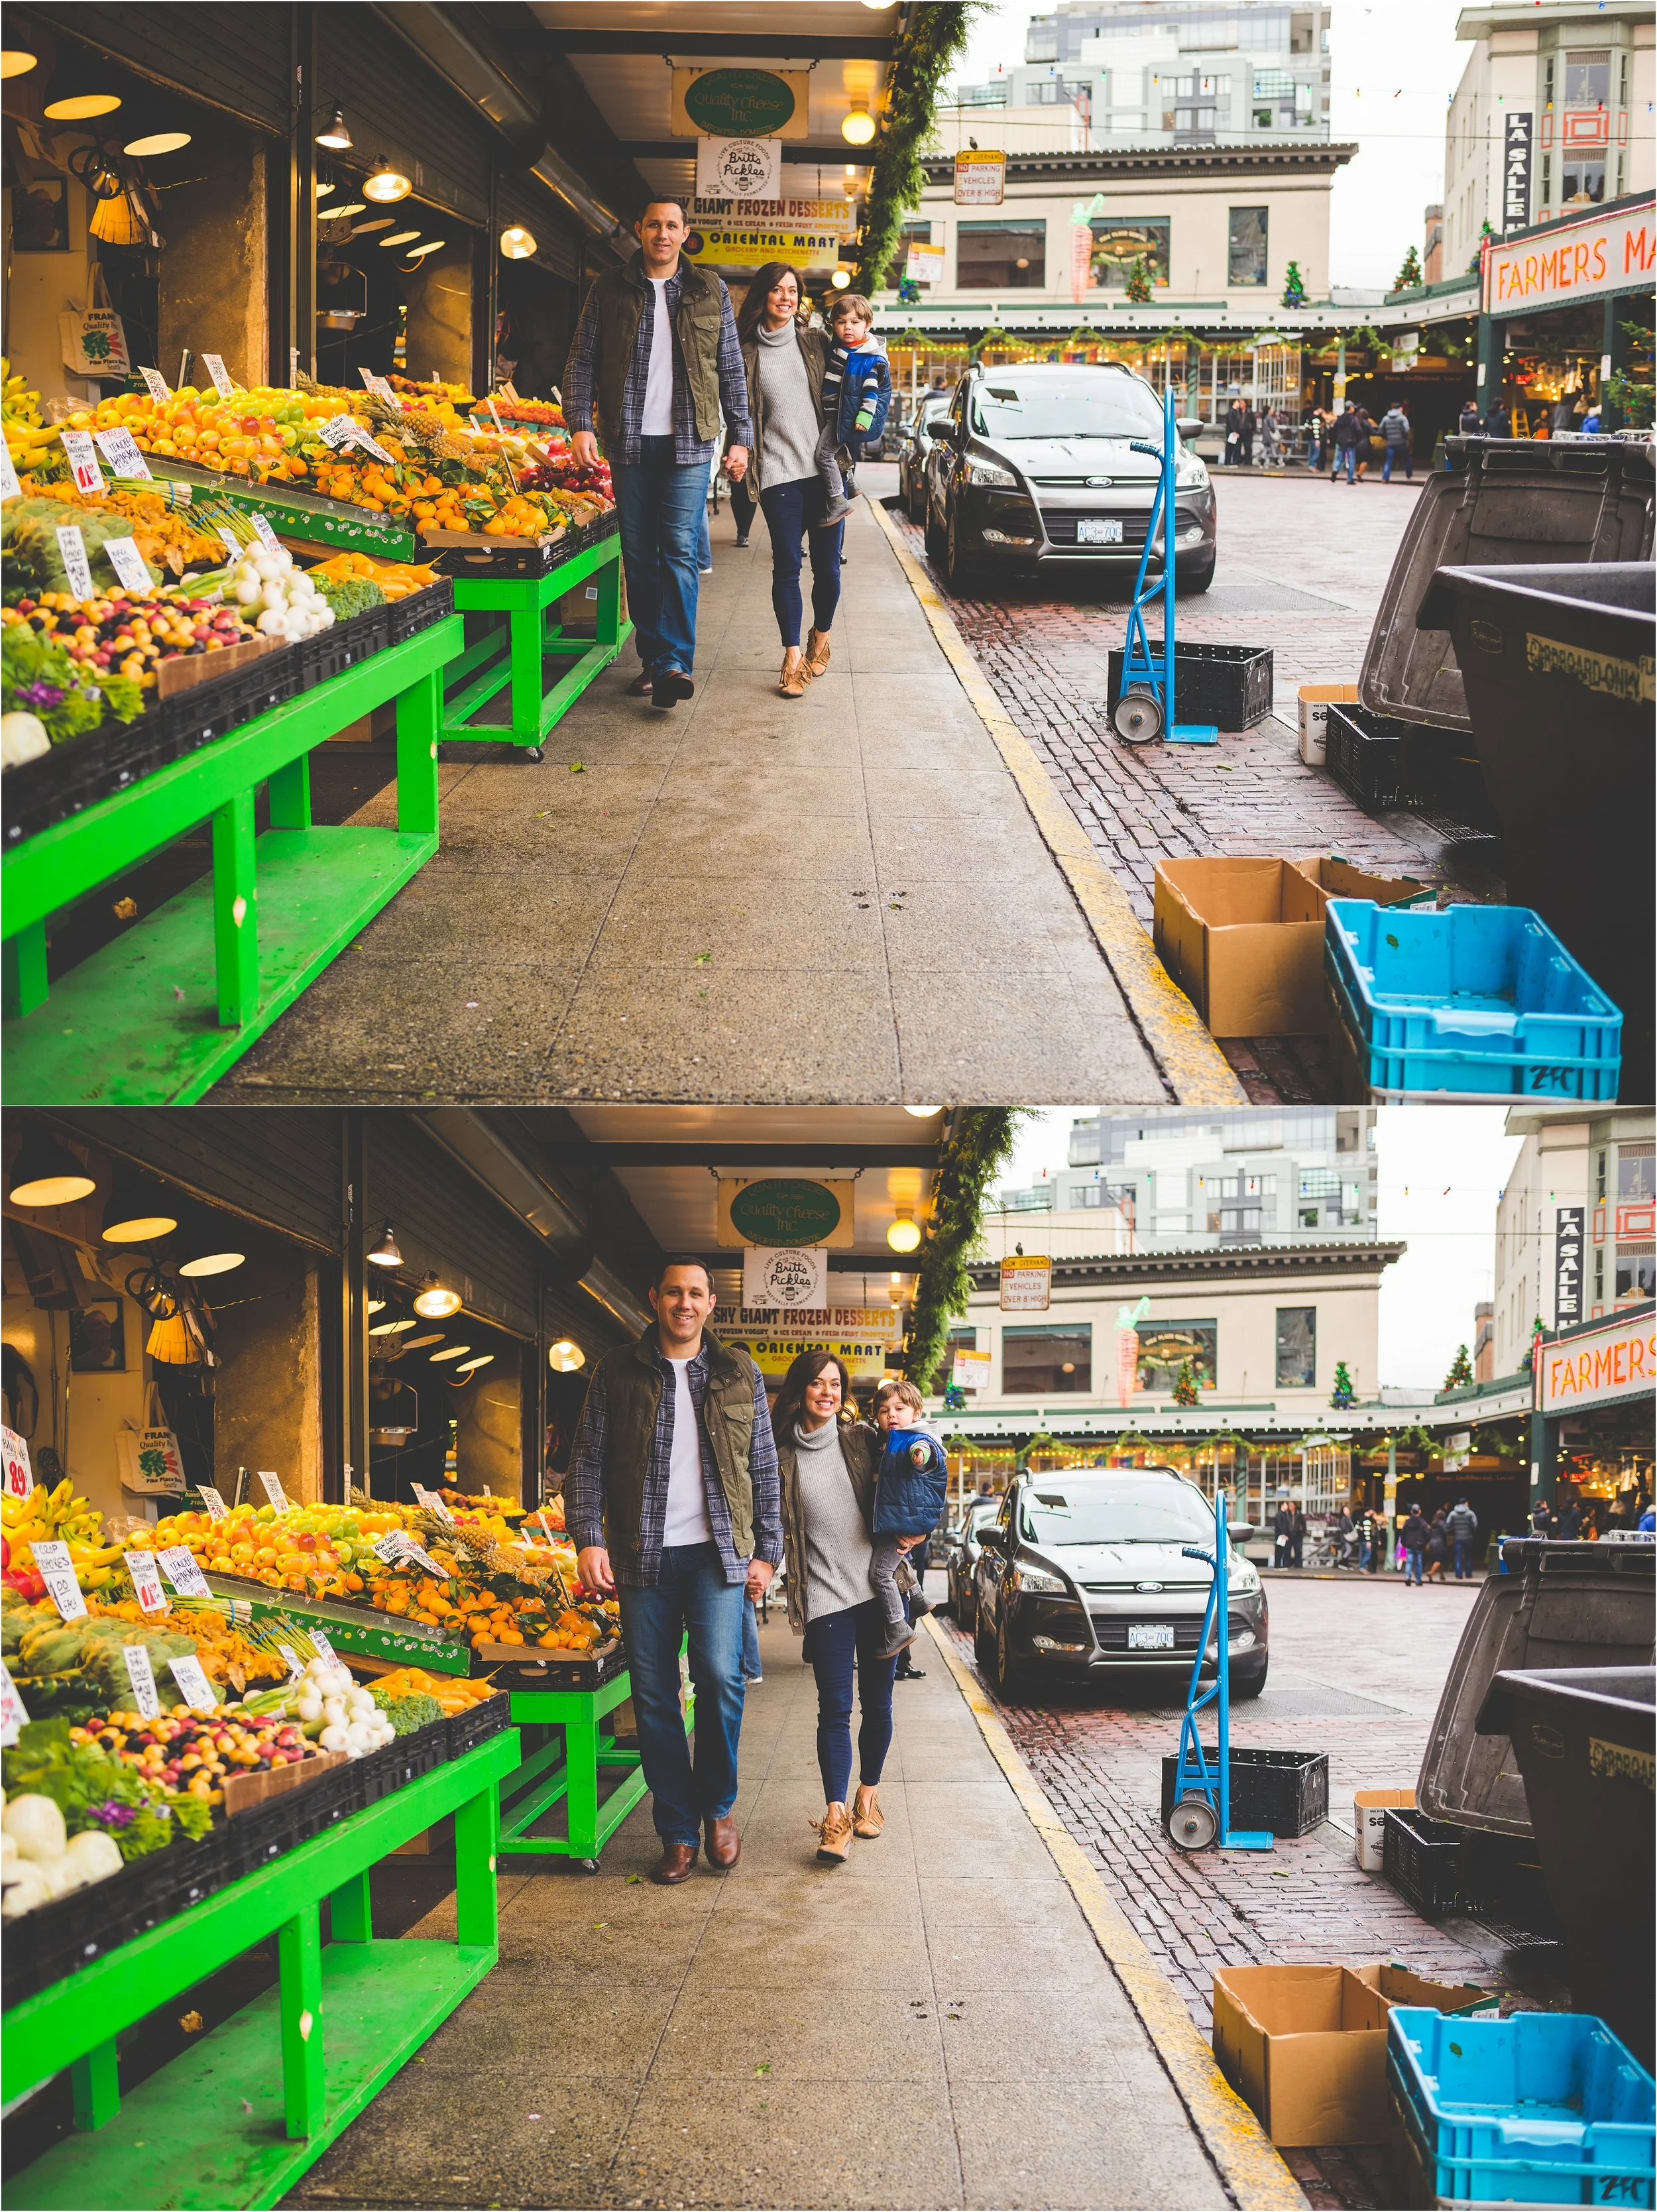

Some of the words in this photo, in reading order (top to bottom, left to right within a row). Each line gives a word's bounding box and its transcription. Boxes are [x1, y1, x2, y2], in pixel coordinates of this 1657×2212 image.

[695, 93, 738, 108] Quality
[732, 108, 752, 122] Inc.
[700, 120, 738, 135] IMPORTED
[740, 124, 775, 136] DOMESTIC
[1509, 114, 1528, 141] LA
[718, 147, 728, 159] LIVE
[755, 143, 770, 160] FOODS
[729, 152, 761, 164] Britt's
[724, 164, 765, 176] Pickles
[1506, 148, 1527, 217] SALLE
[694, 199, 734, 215] GIANT
[737, 200, 785, 216] FROZEN
[789, 200, 850, 219] DESSERTS
[710, 232, 785, 246] ORIENTAL
[793, 236, 835, 248] MART
[1497, 237, 1607, 300] FARMERS
[319, 427, 330, 436] NEW
[330, 418, 343, 429] CROP
[108, 437, 136, 453] TENDER
[1079, 527, 1096, 538] AC3
[740, 1204, 784, 1218] Quality
[1560, 1209, 1579, 1237] LA
[746, 1231, 782, 1246] IMPORTED
[785, 1233, 821, 1246] DOMESTIC
[764, 1257, 774, 1269] LIVE
[774, 1250, 801, 1258] CULTURE
[801, 1253, 817, 1270] FOODS
[775, 1261, 807, 1274] Britt's
[770, 1273, 811, 1285] Pickles
[1558, 1244, 1579, 1312] SALLE
[713, 1307, 736, 1324] SHY
[740, 1308, 779, 1325] GIANT
[783, 1309, 832, 1326] FROZEN
[835, 1309, 895, 1327] DESSERTS
[840, 1344, 882, 1356] MART
[140, 1440, 165, 1449] Quality
[9, 1461, 26, 1496] 89
[374, 1543, 385, 1552] NEW
[384, 1533, 397, 1544] CROP
[170, 1555, 196, 1572] TENDER
[1130, 1633, 1148, 1643] AC3
